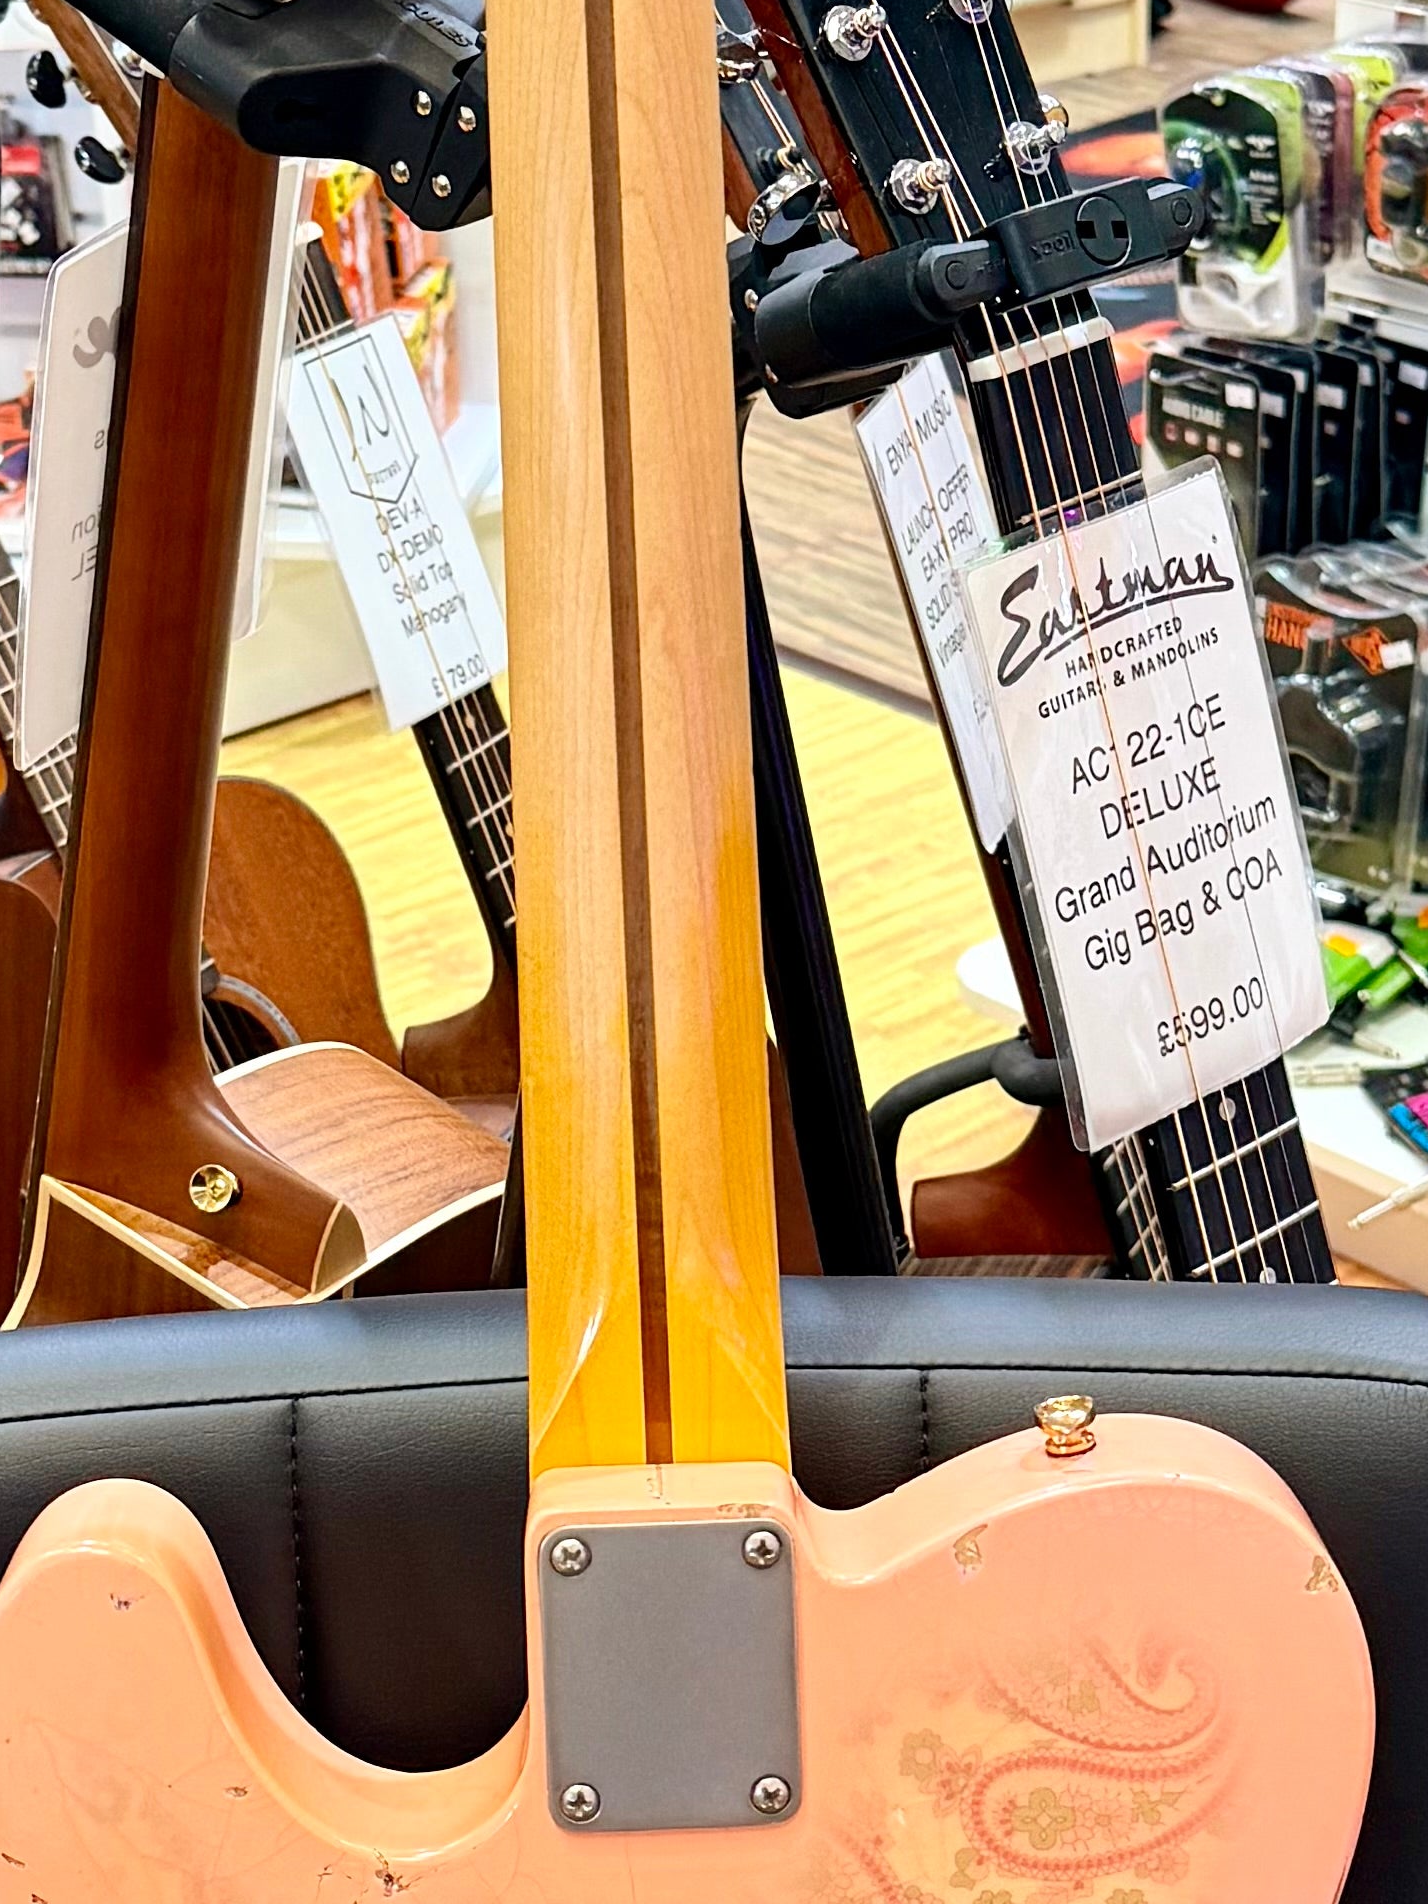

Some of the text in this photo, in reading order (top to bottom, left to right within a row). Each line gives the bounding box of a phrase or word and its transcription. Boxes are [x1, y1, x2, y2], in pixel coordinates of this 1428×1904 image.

[885, 389, 953, 477] ENYA MUSIC
[899, 462, 973, 557] LAUNCH OFFER
[948, 511, 975, 551] PRO
[392, 560, 455, 605] Solid Top
[401, 590, 470, 640] Mahogany
[925, 580, 951, 632] SOLID
[996, 551, 1236, 689] Eastman
[431, 653, 487, 699] £79.00
[936, 620, 968, 670] Vintage
[1037, 626, 1220, 720] GUITARS & MANDOLINS
[1064, 615, 1184, 680] HANDCRAFTED
[1070, 692, 1228, 795] AC22-1CE
[1098, 755, 1223, 841] DELUXE
[1055, 795, 1279, 924] Grand Auditorium
[1083, 846, 1284, 973] Gig Bag & COA
[1156, 975, 1266, 1058] £599.00
